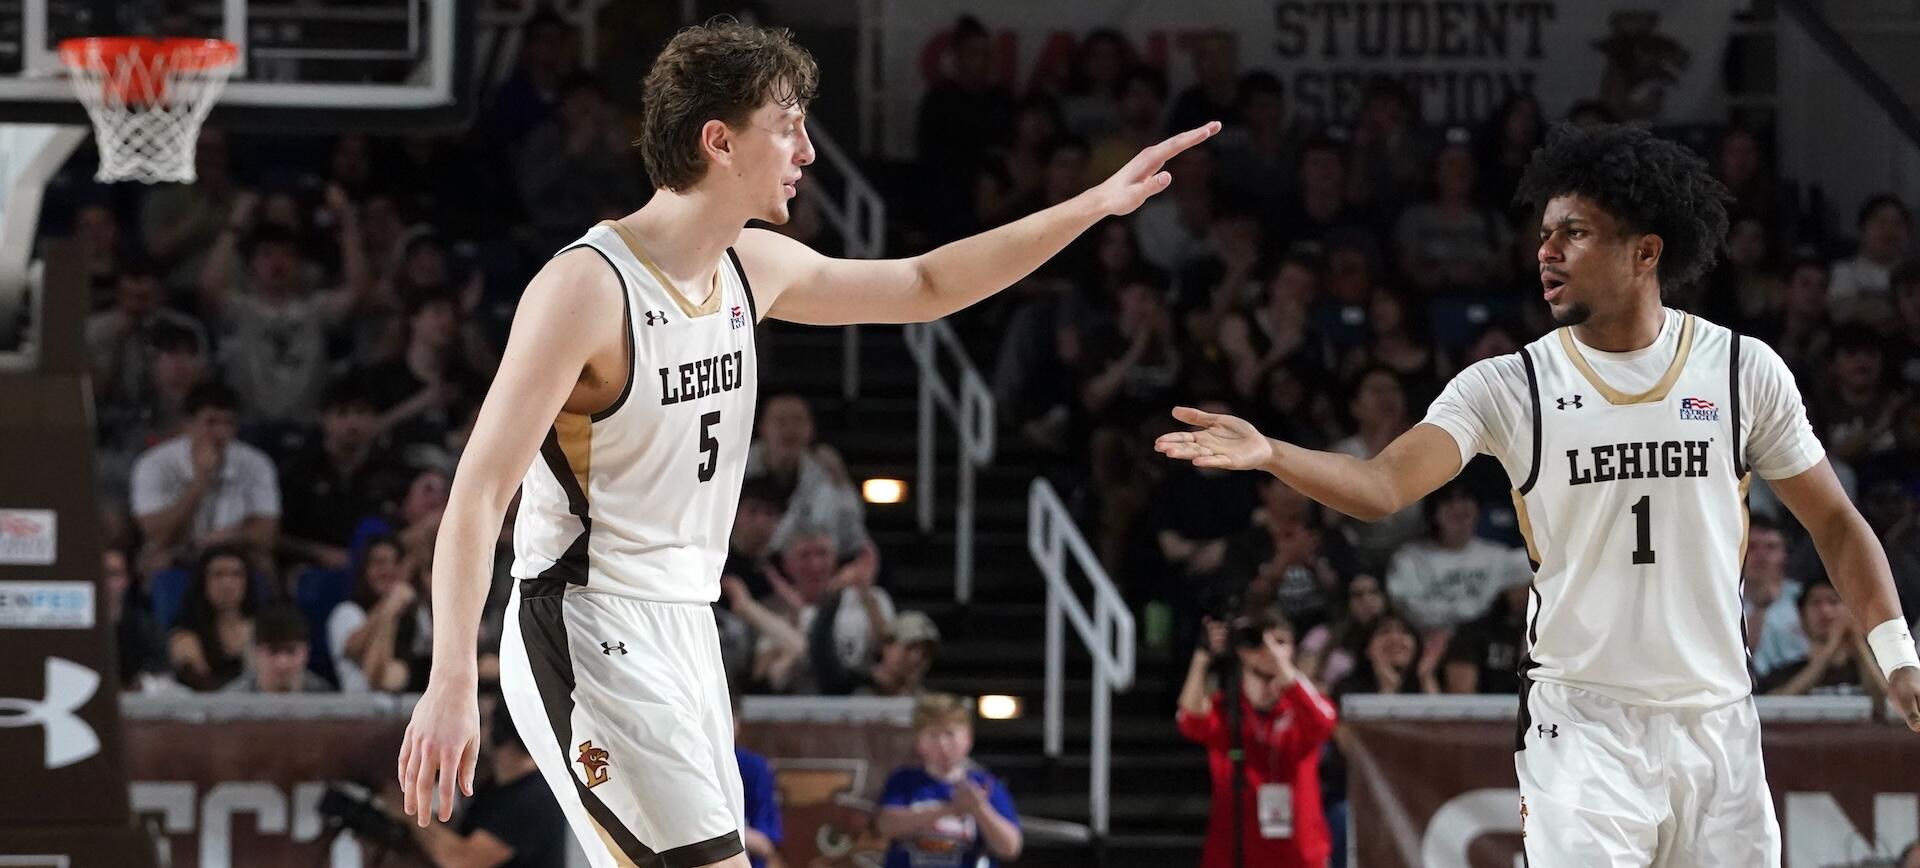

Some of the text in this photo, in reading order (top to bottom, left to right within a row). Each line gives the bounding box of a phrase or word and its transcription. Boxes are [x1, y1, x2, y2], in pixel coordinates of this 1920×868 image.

[1274, 0, 1555, 57] STUDENT
[1294, 71, 1536, 124] SETION
[1681, 408, 1718, 416] PATRIOT
[698, 410, 721, 483] 5
[1566, 440, 1709, 485] LEHIGH
[1631, 495, 1655, 565] 1
